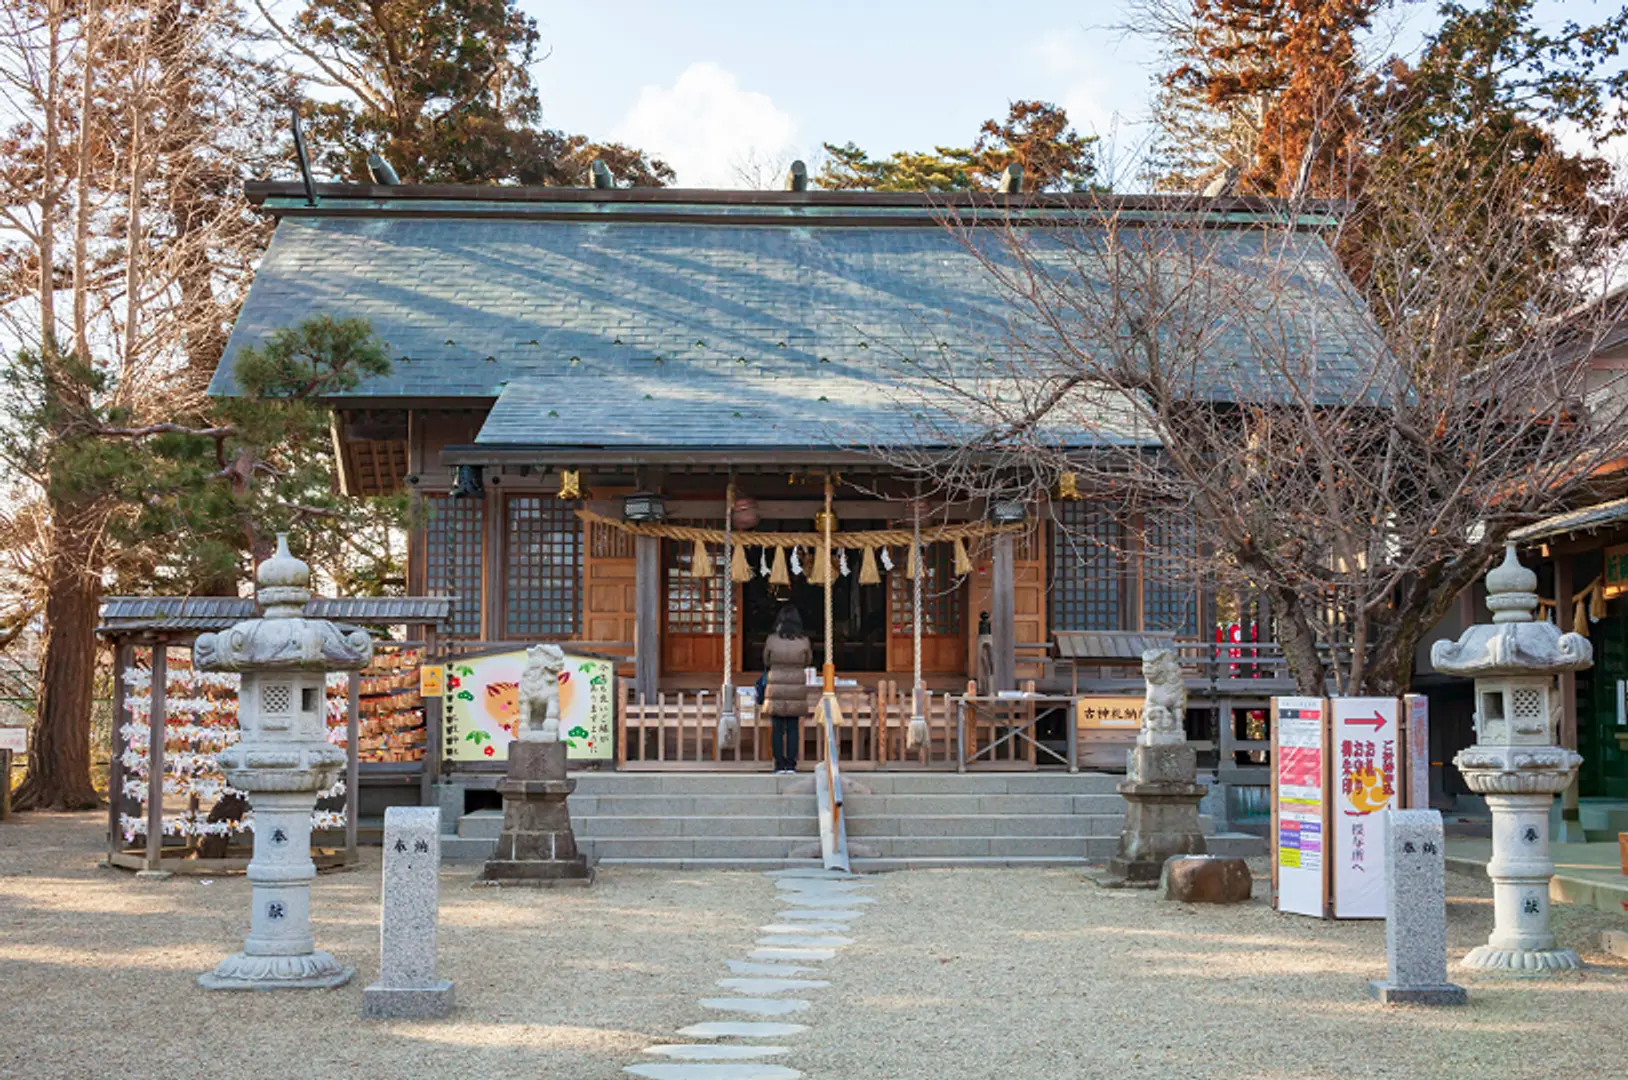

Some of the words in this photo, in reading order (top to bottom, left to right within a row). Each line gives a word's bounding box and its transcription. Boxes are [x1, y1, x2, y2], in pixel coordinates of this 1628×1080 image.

[1084, 706, 1142, 720] 古神札納
[1341, 739, 1353, 796] 御朱印
[1354, 739, 1363, 795] お守り
[1352, 823, 1365, 872] 授与所へ
